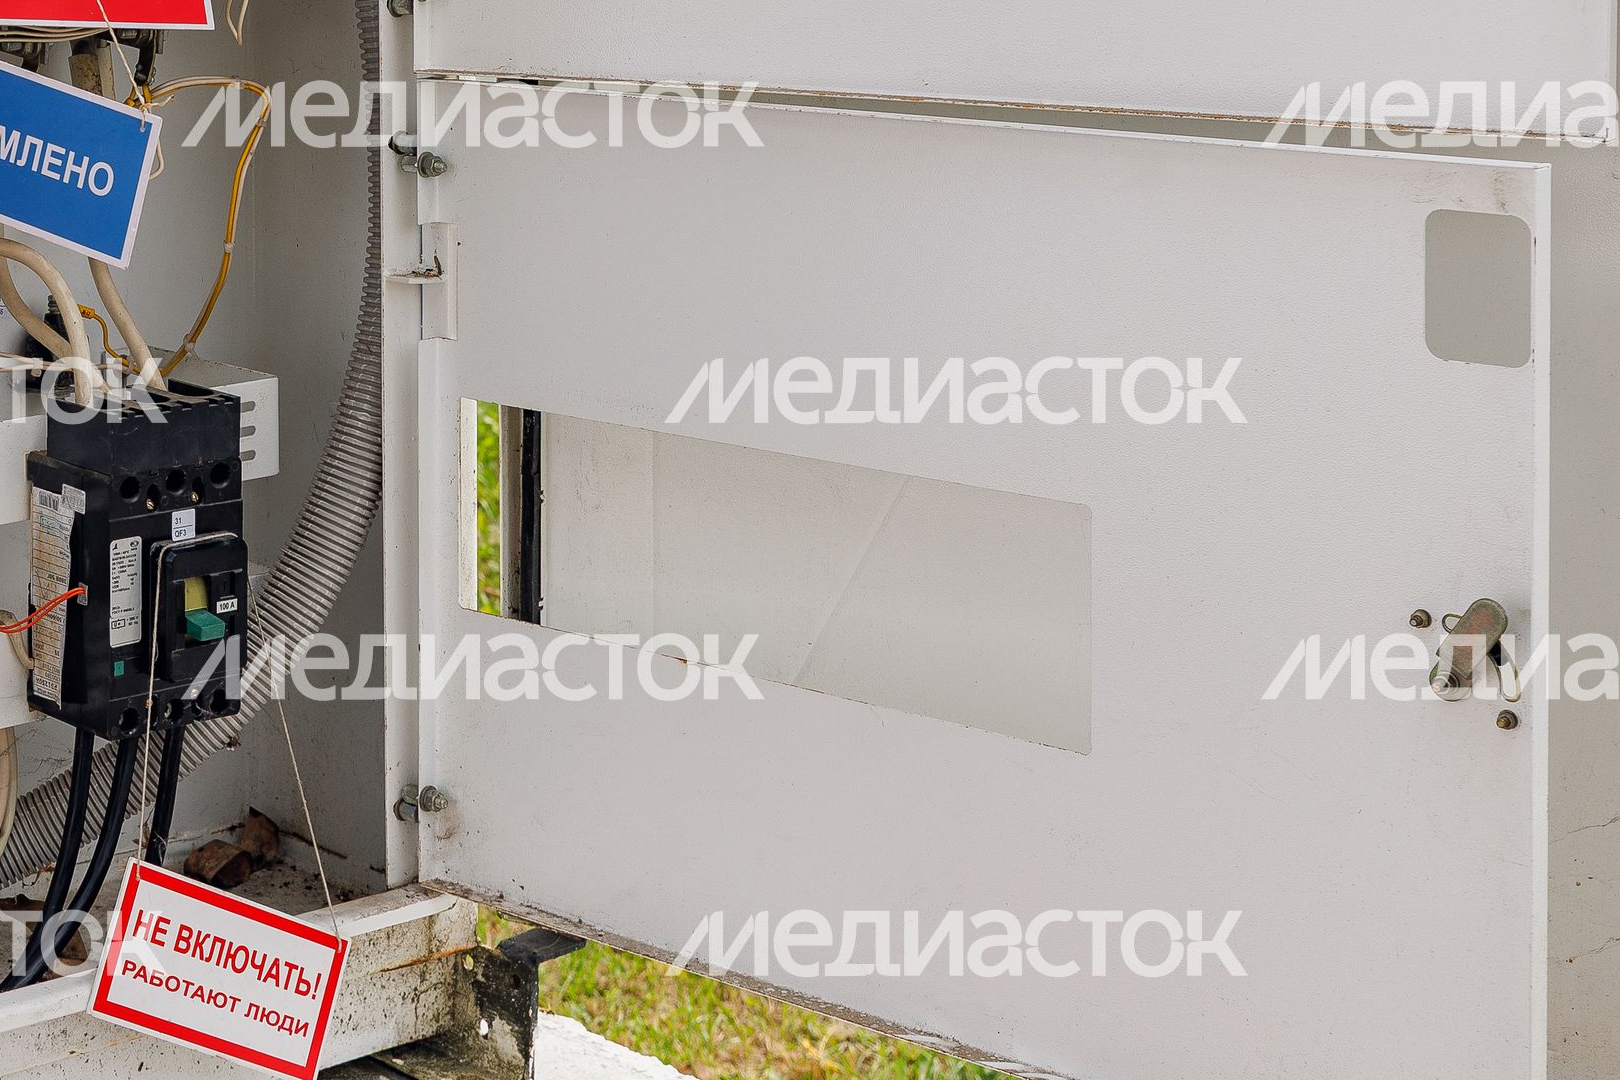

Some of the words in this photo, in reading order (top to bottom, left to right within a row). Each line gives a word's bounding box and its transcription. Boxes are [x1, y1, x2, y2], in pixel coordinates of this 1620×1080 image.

[174, 516, 182, 525] 31
[174, 529, 187, 538] QF3
[219, 602, 229, 611] 100
[230, 601, 236, 609] A
[132, 909, 171, 948] НЕ
[173, 924, 323, 1001] ВКЛЮЧАТЬ!
[121, 959, 242, 1014] РАБОТАЮТ
[244, 1002, 311, 1038] ЛЮДИ
